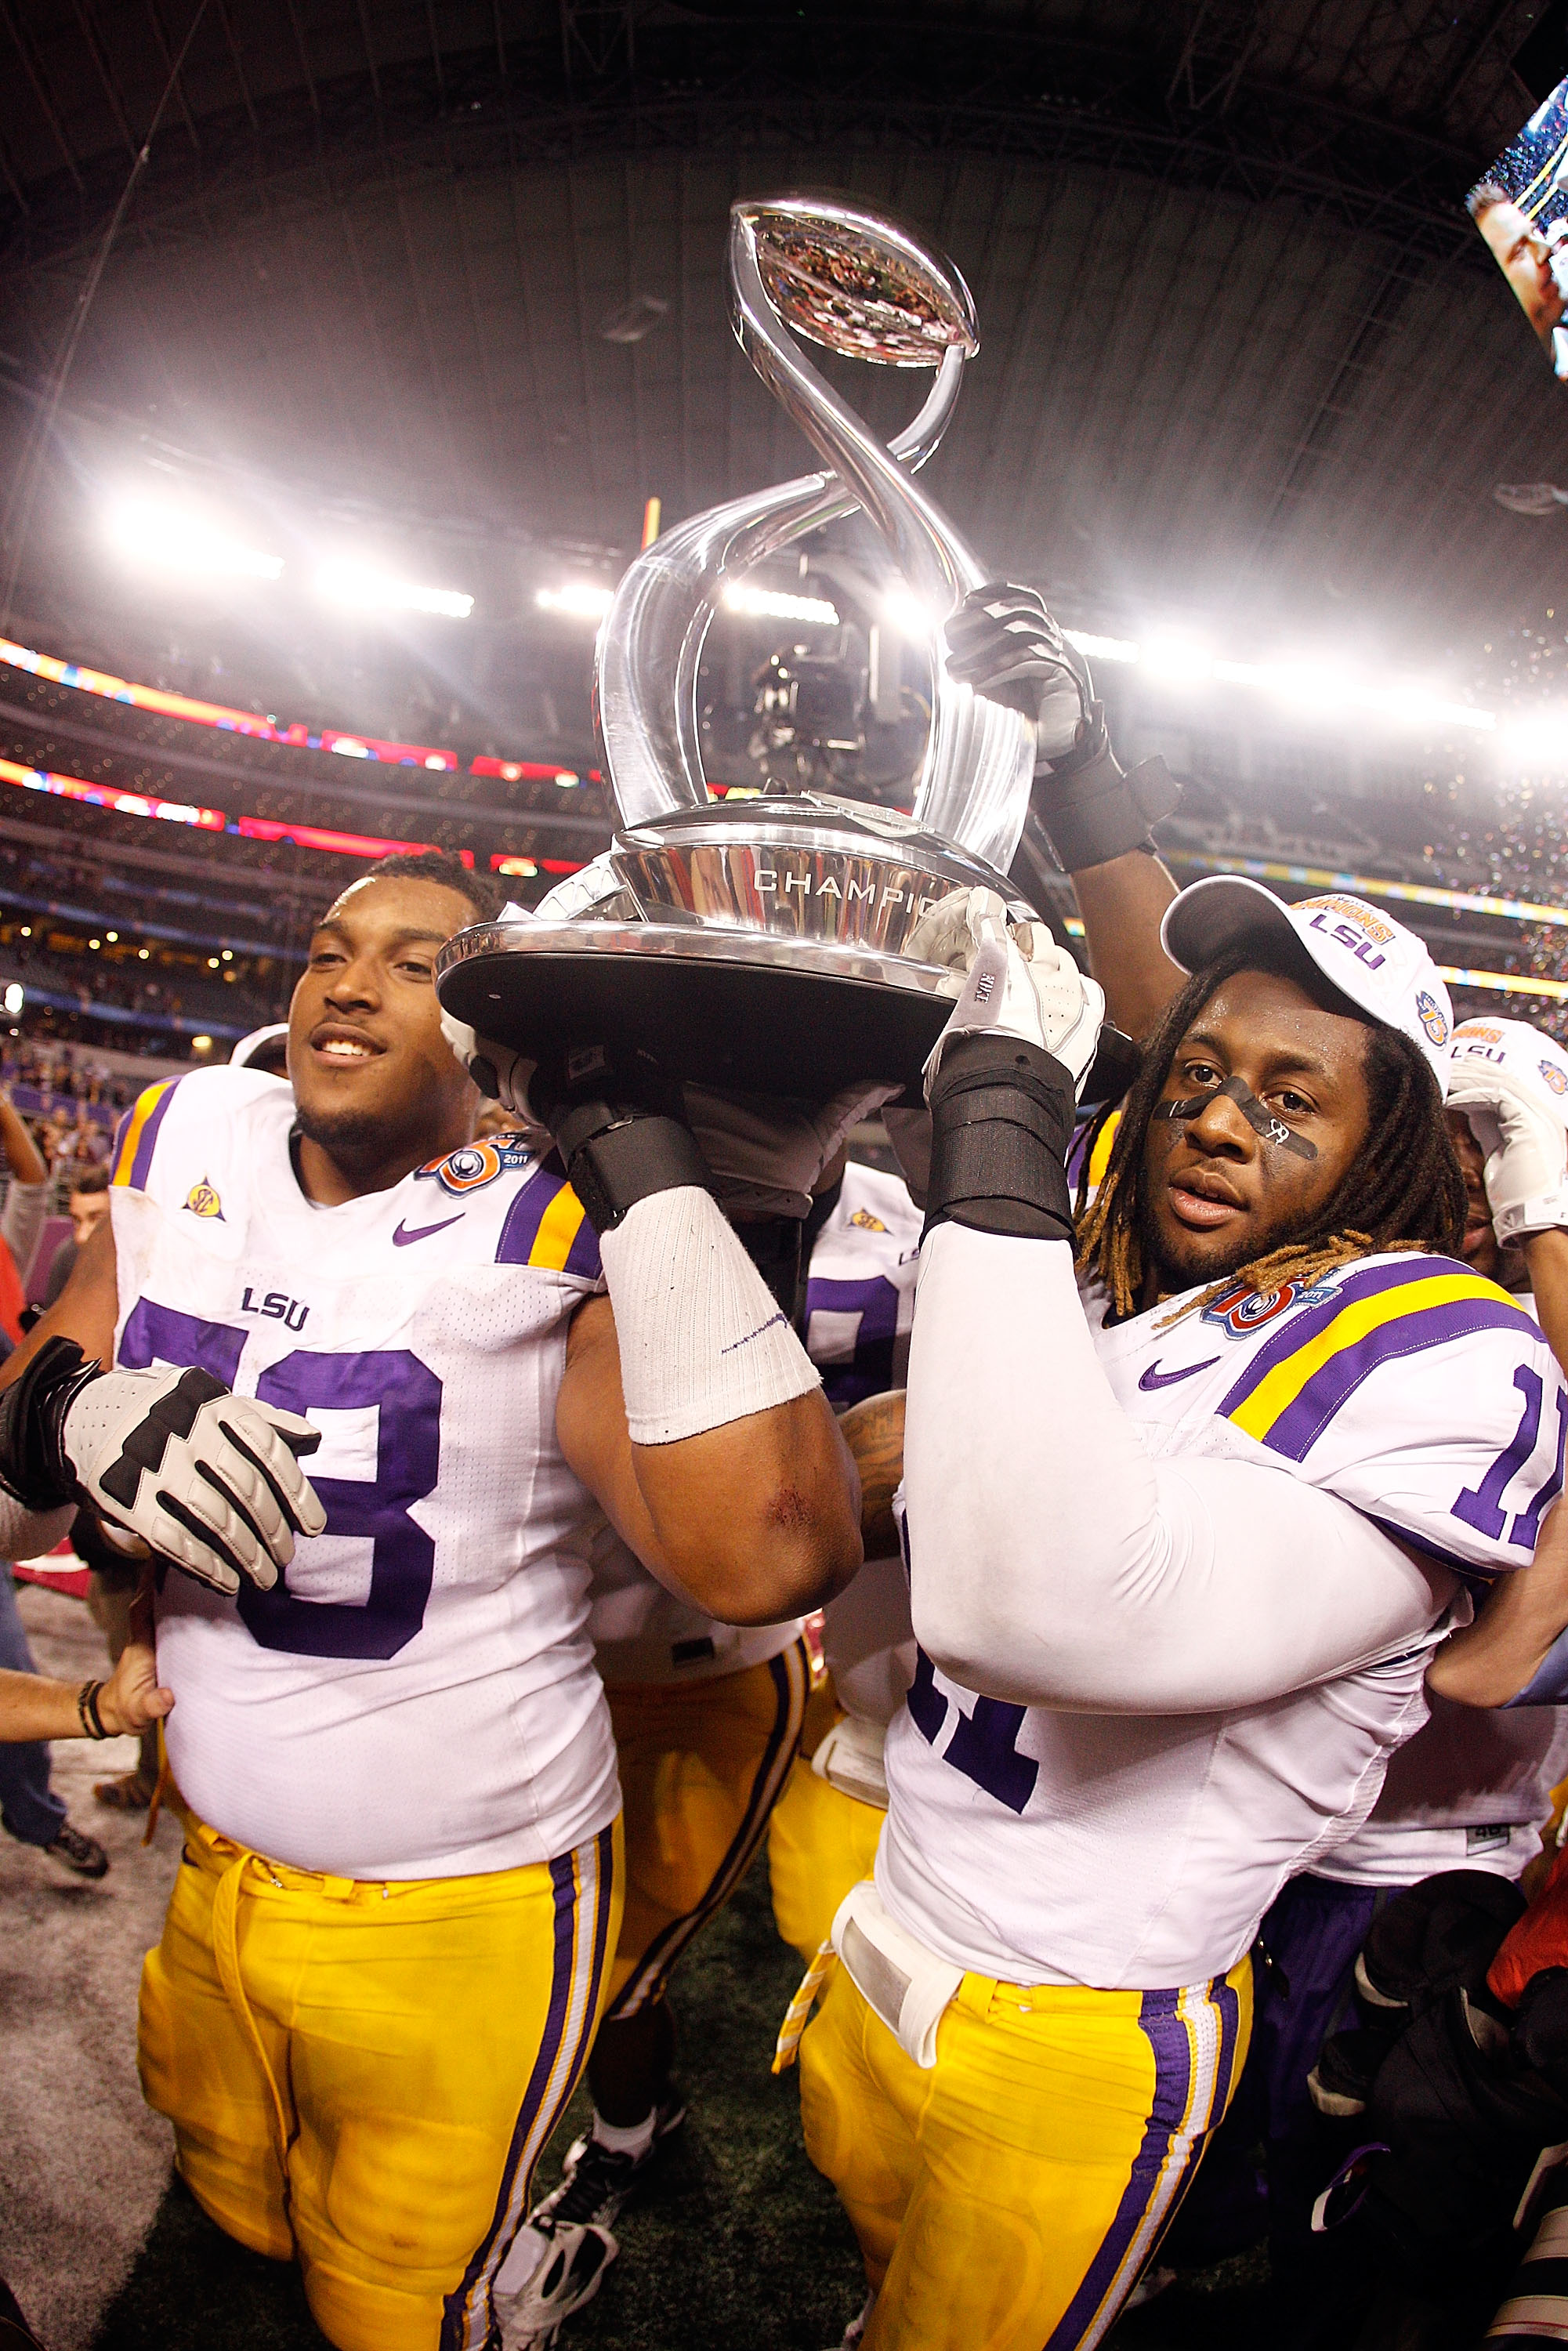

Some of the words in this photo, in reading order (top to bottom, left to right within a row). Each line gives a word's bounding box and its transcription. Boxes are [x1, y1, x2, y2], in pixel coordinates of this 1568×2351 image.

[1309, 914, 1386, 970] LSU
[503, 1154, 528, 1165] 2011
[1297, 1290, 1324, 1300] 2011
[241, 1287, 311, 1332] LSU
